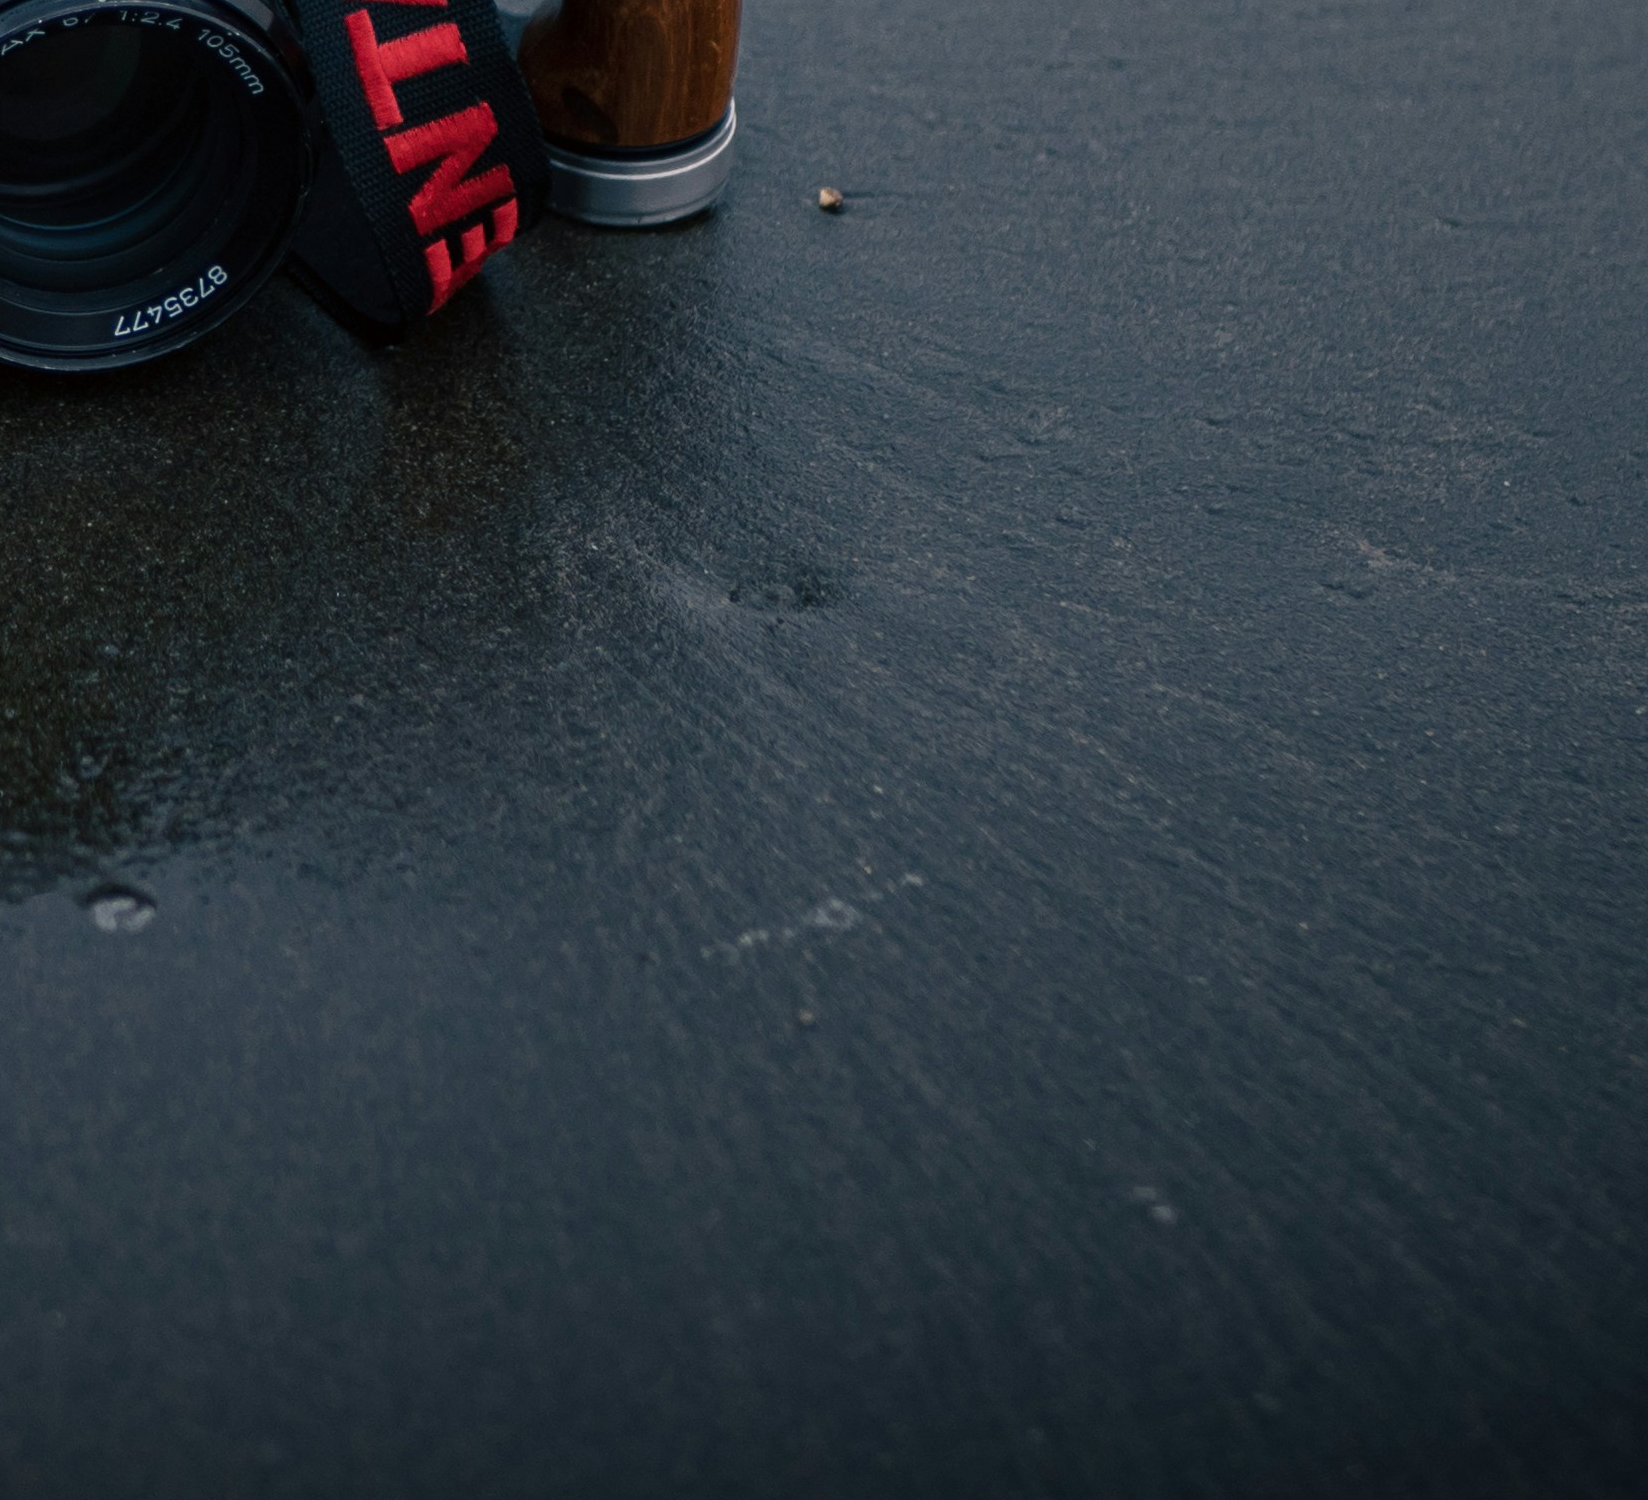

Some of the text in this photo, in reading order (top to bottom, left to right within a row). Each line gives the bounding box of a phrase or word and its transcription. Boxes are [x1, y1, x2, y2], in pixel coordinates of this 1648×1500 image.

[119, 10, 184, 30] 1:2.4
[198, 28, 264, 95] 105mm
[114, 265, 228, 336] 8735477
